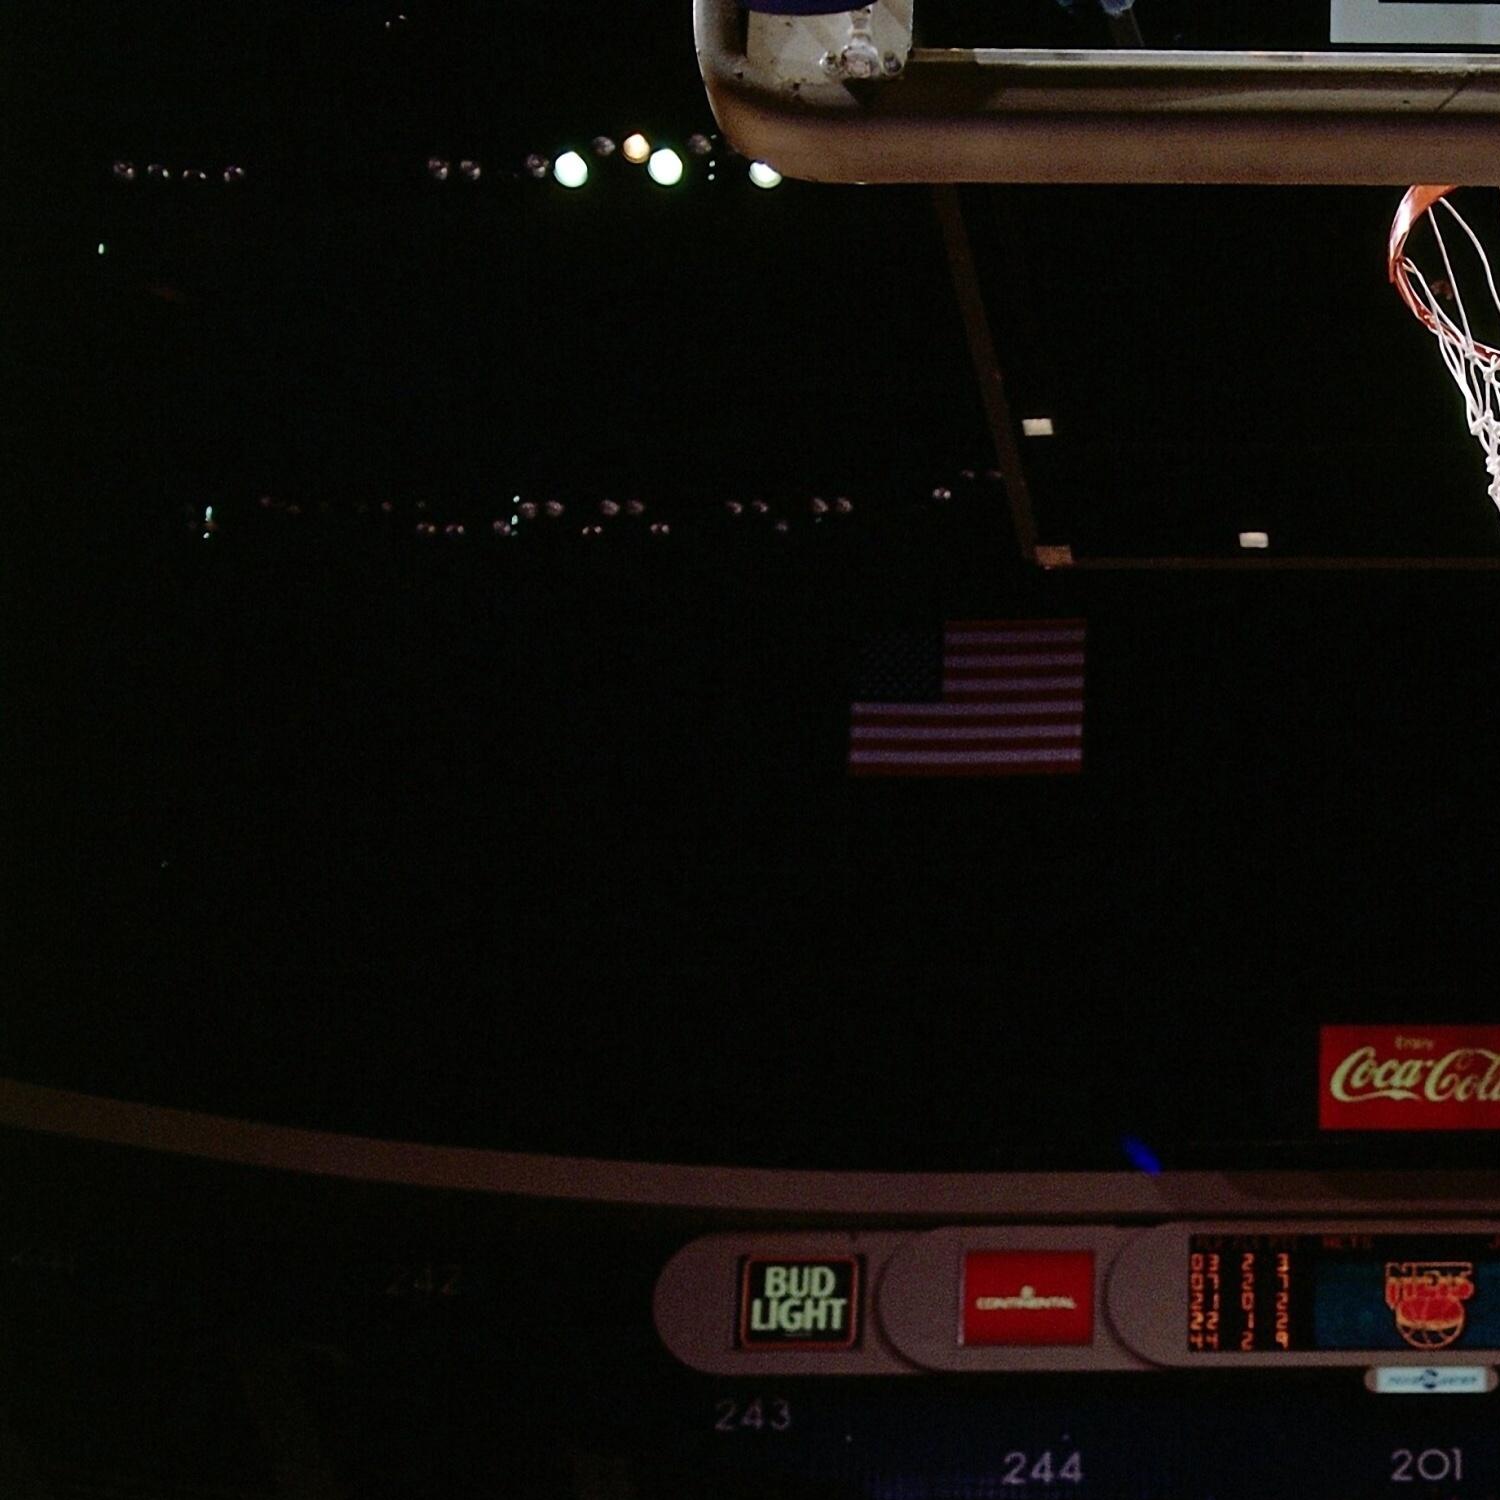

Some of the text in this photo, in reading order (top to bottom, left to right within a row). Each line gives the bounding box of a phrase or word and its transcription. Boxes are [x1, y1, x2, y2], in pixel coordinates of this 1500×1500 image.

[763, 1265, 836, 1298] BUD
[751, 1298, 848, 1332] LIGHT
[713, 1399, 793, 1432] 243
[1002, 1451, 1086, 1485] 244
[1390, 1447, 1465, 1482] 201
